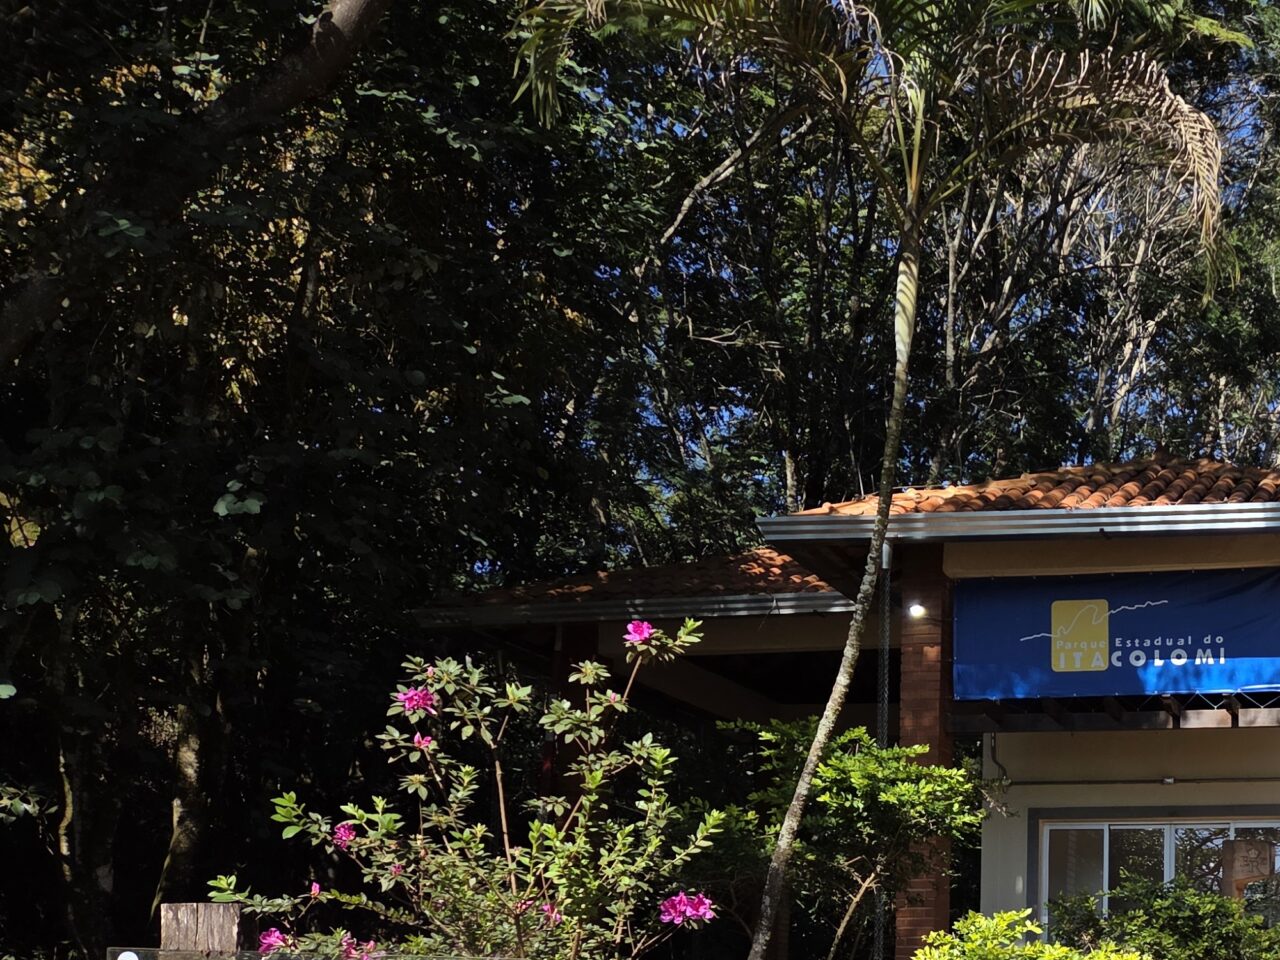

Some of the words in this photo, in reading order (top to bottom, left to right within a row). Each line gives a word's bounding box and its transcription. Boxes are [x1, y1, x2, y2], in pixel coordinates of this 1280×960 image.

[1056, 640, 1106, 651] Parque
[1115, 636, 1192, 647] Estadual
[1203, 634, 1224, 644] do
[1059, 647, 1226, 668] ITACOLOMI
